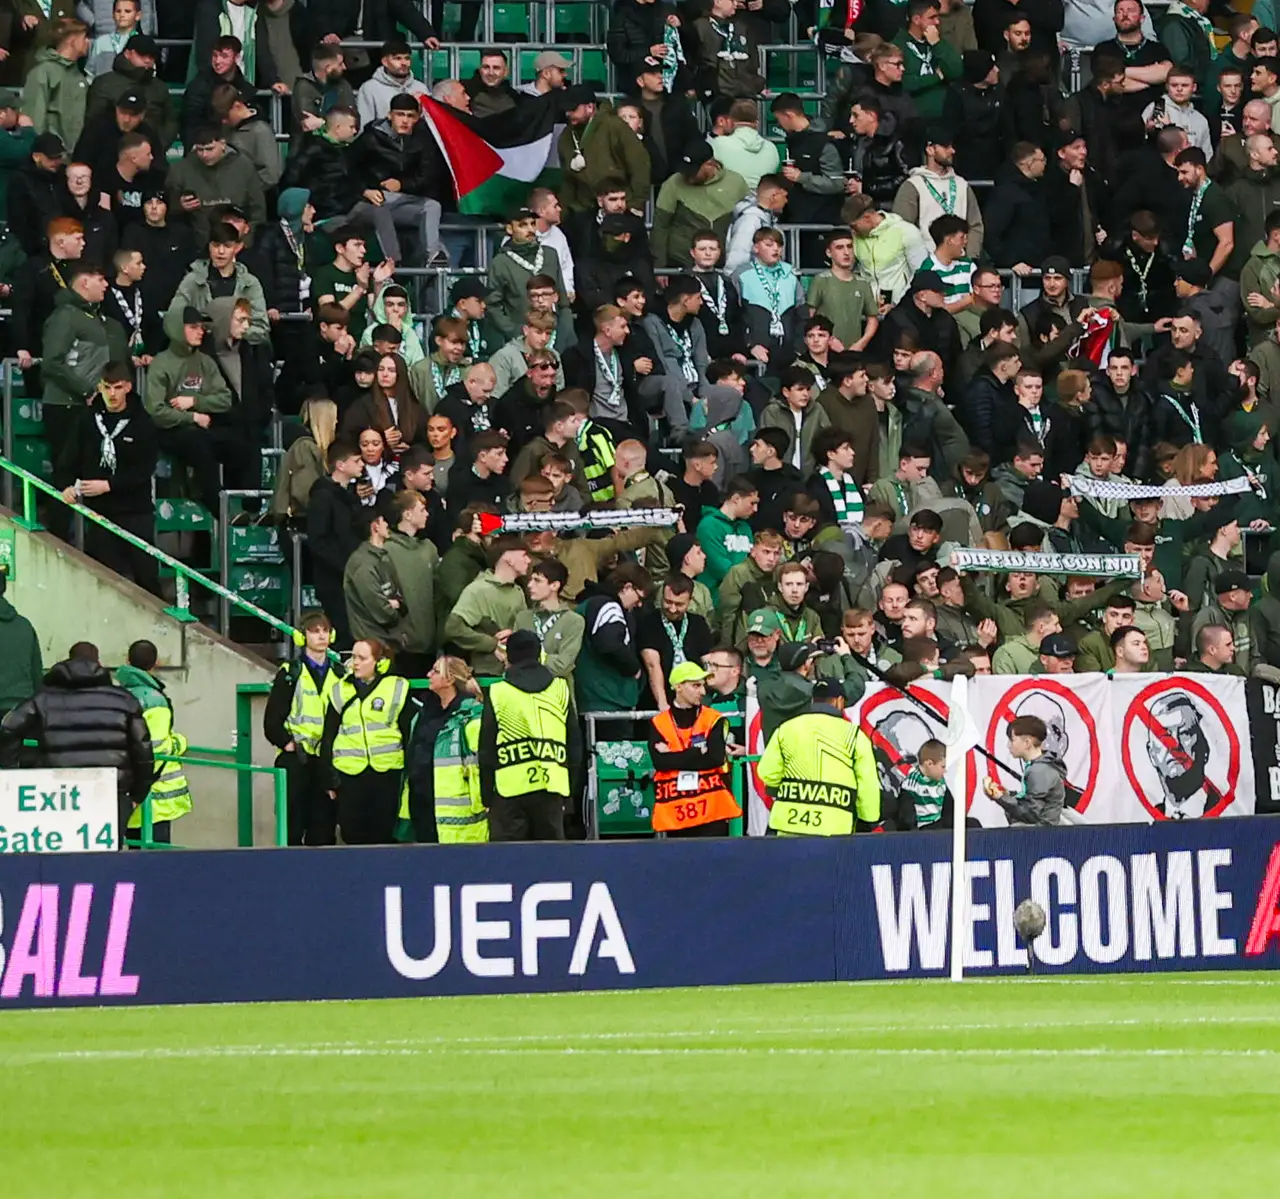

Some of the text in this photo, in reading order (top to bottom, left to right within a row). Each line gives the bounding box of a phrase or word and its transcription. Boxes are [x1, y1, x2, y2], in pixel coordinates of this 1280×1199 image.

[1062, 558, 1101, 572] CON
[1105, 558, 1140, 575] NOI
[17, 784, 82, 812] Exit
[777, 780, 852, 807] STEWARD
[673, 799, 709, 823] 387
[787, 807, 823, 828] 243
[76, 822, 115, 850] 14
[870, 848, 1238, 973] WELCOME
[384, 881, 637, 981] UEFA
